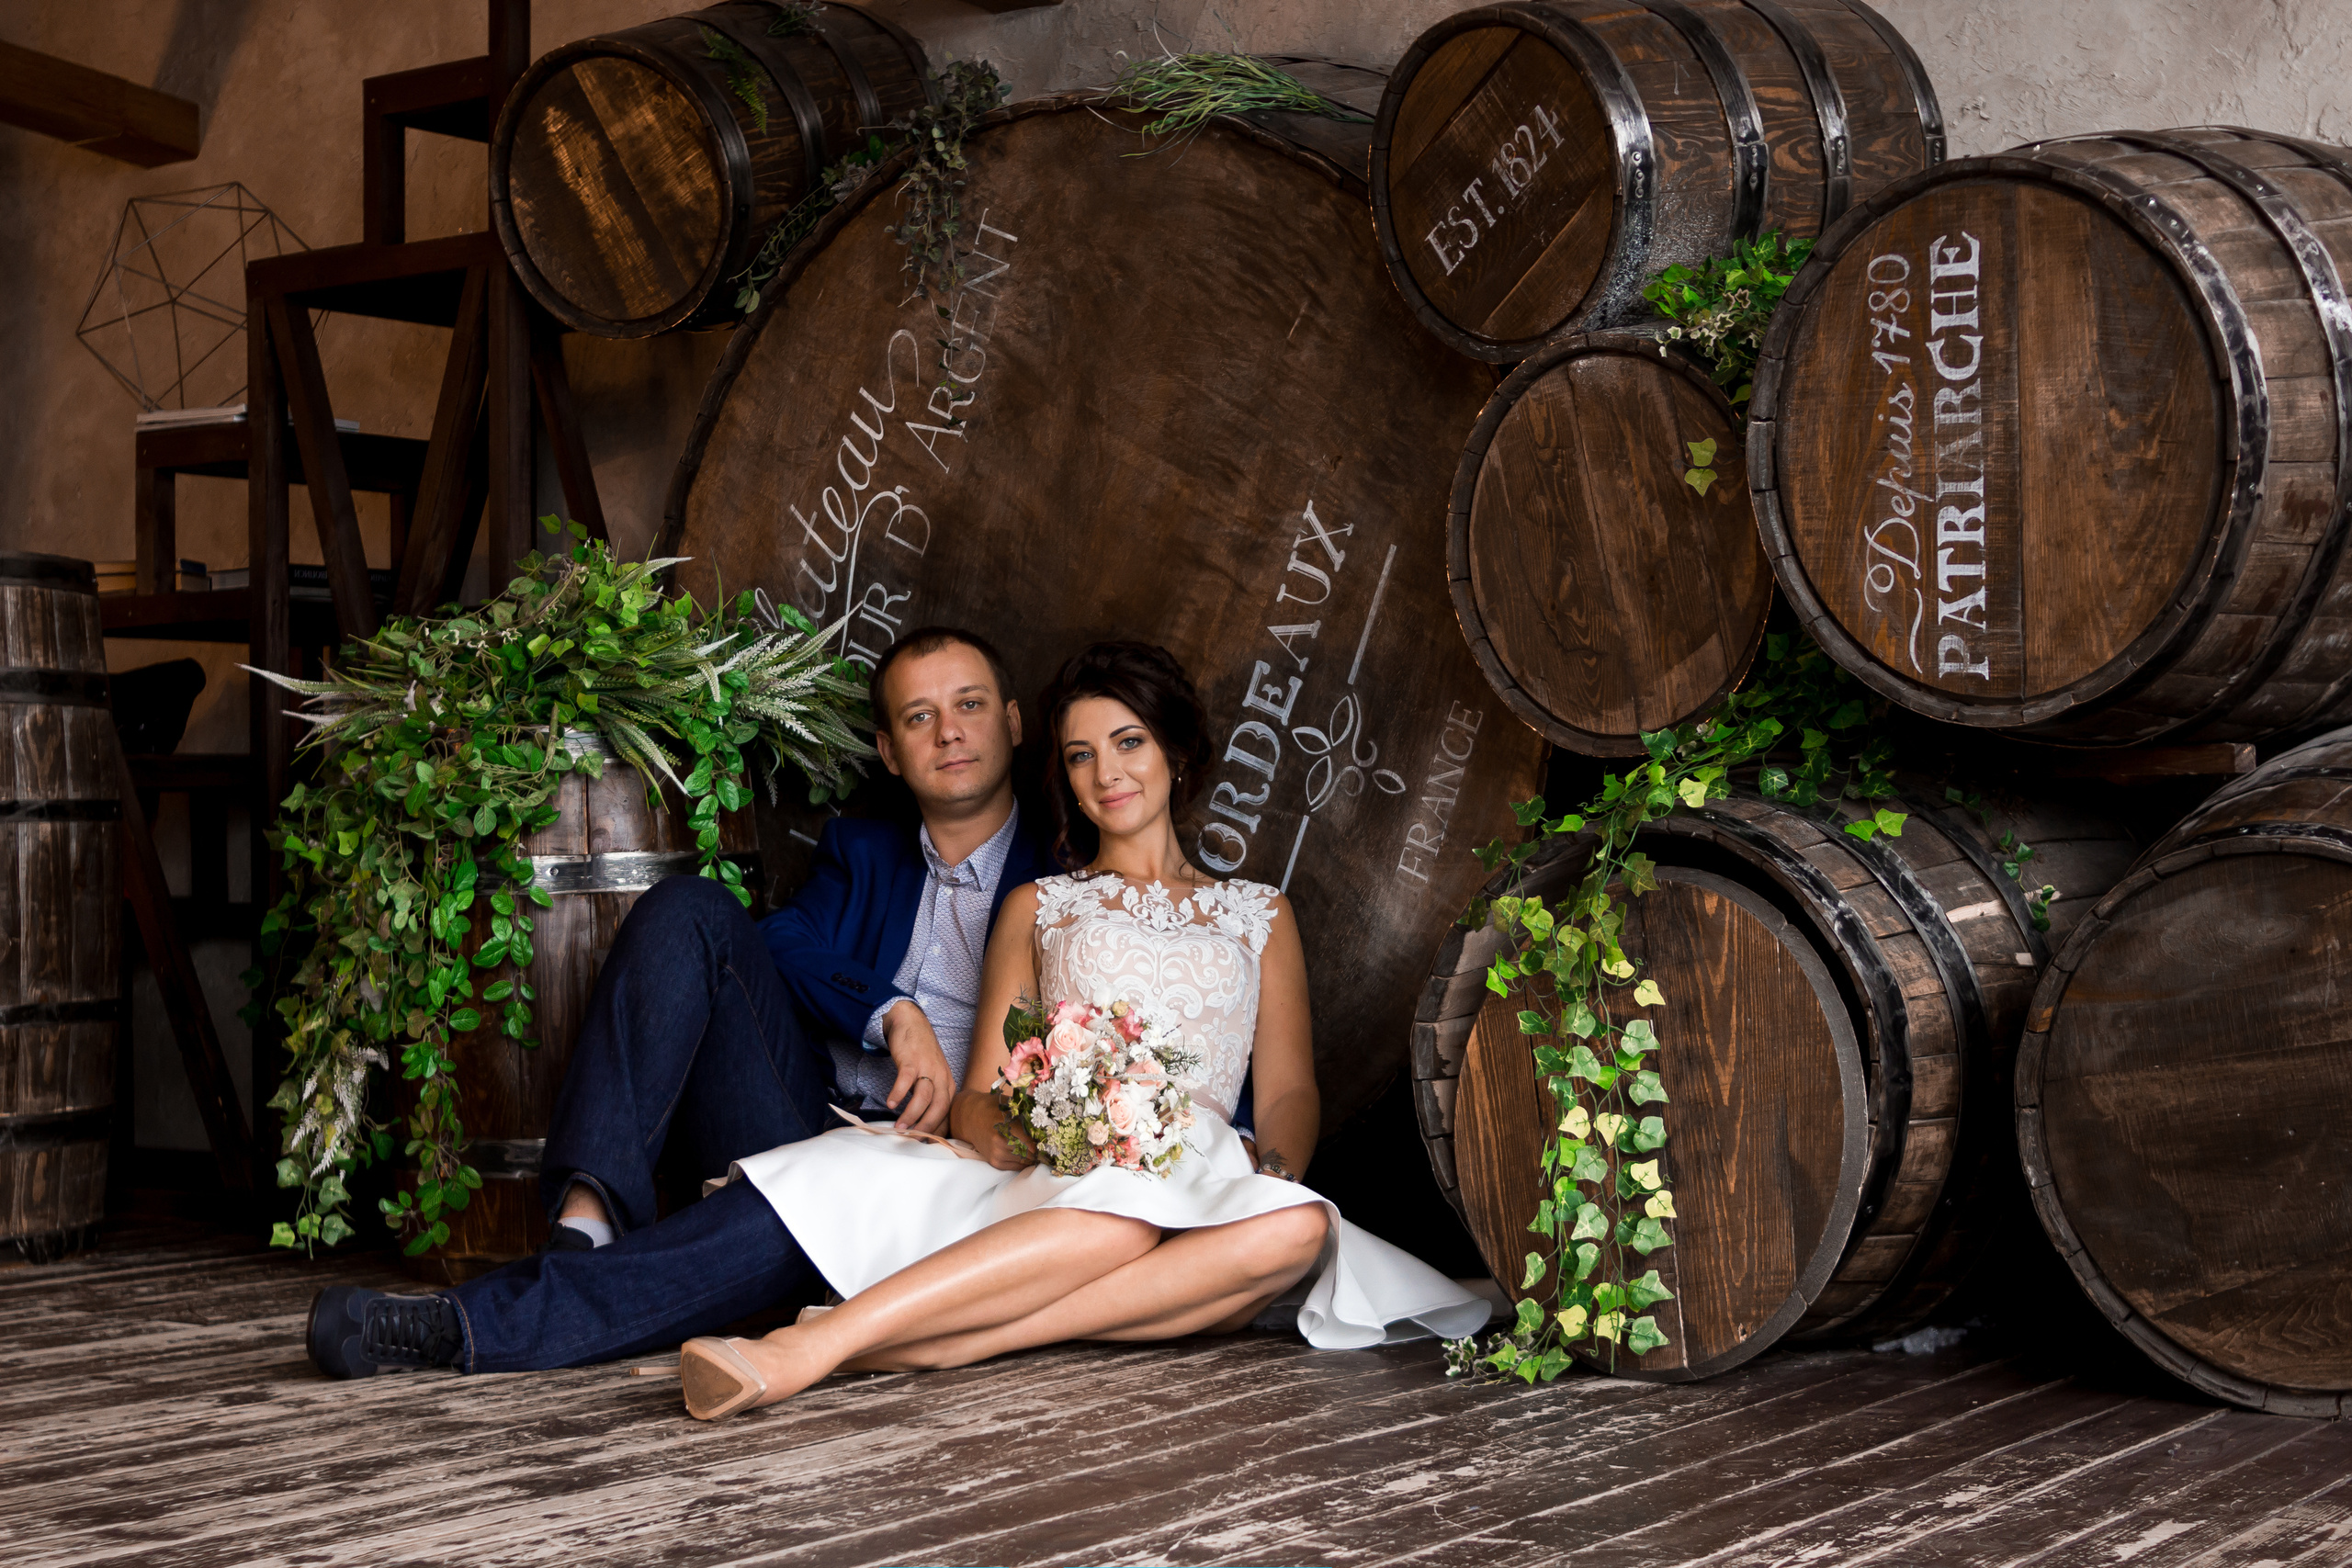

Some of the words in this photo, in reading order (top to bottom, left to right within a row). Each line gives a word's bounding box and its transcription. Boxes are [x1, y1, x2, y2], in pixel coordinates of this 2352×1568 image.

[1492, 104, 1565, 200] 1824
[1867, 254, 1911, 375] 1780
[1864, 382, 1934, 613] Depuis
[1925, 231, 1990, 681] PATRIARCHE
[1197, 500, 1354, 873] ORDEAUX
[1396, 699, 1484, 884] FRANCE
